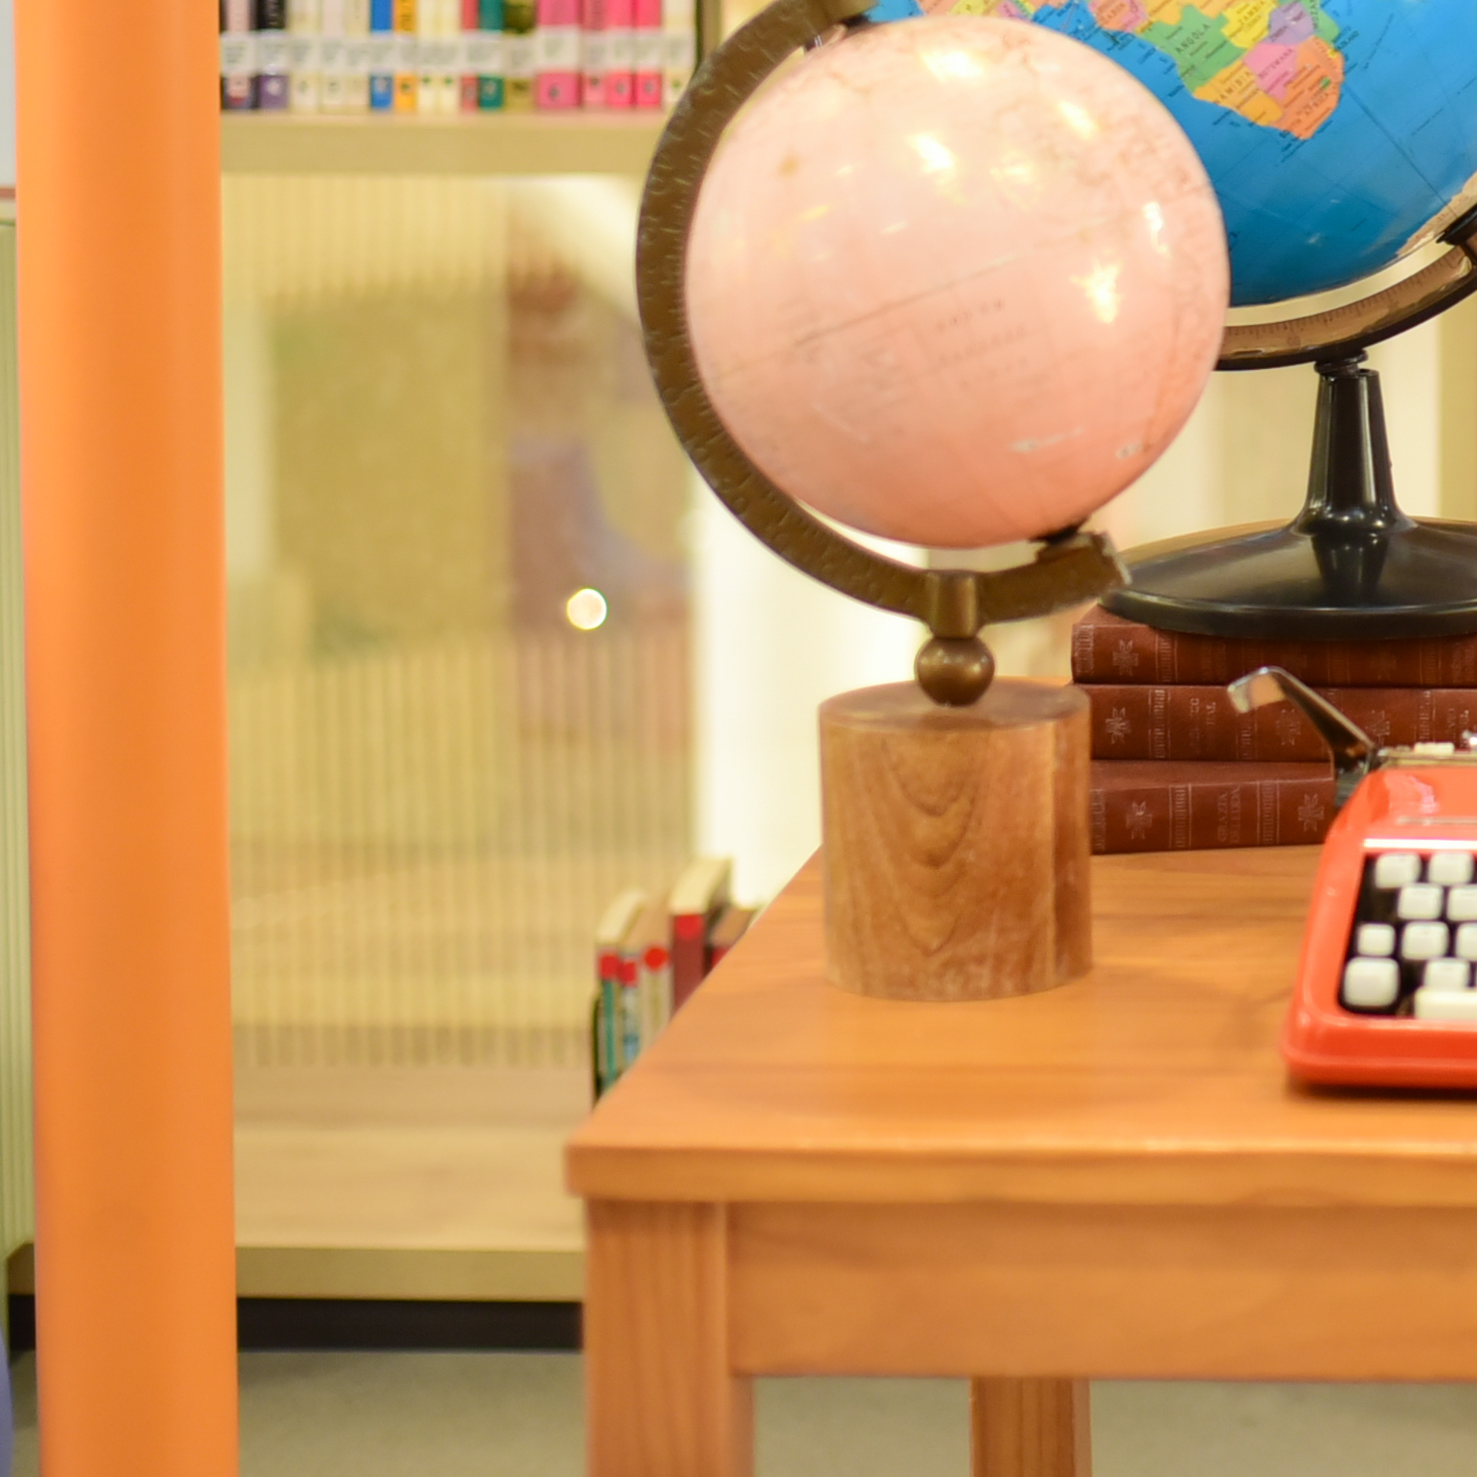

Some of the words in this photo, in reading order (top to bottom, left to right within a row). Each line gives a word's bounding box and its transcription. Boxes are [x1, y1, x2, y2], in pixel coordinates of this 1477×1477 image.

[1238, 0, 1266, 28] ZAMBIA
[1175, 22, 1212, 55] ANGOLA
[1257, 47, 1294, 80] BOTSWANA
[1213, 71, 1251, 105] NAMIBIA
[1217, 792, 1228, 842] GRAZIA
